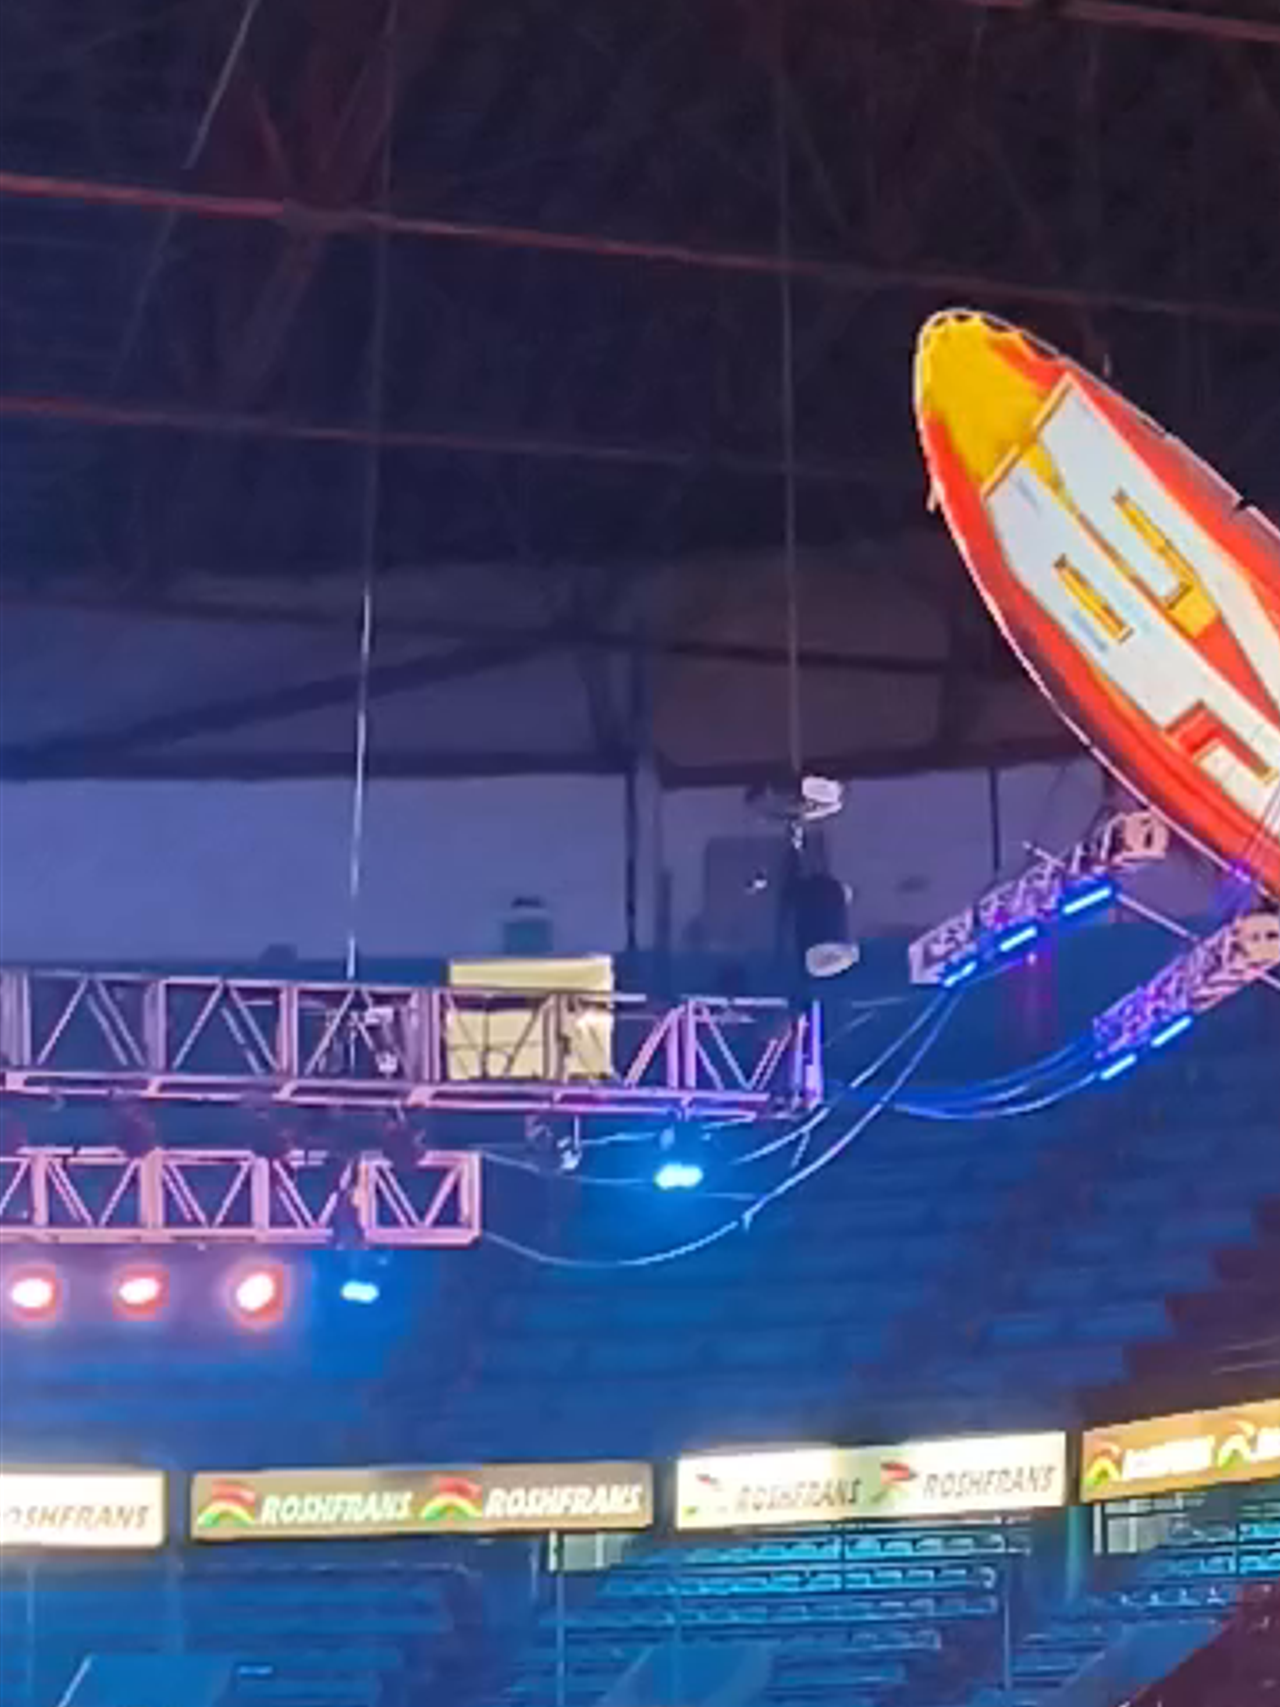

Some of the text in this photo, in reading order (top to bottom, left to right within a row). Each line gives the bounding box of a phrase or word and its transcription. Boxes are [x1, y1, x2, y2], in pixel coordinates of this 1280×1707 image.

[921, 1465, 1057, 1500] ROSHFRANS
[261, 1484, 643, 1525] ROSHFRANS ROSHFRANS
